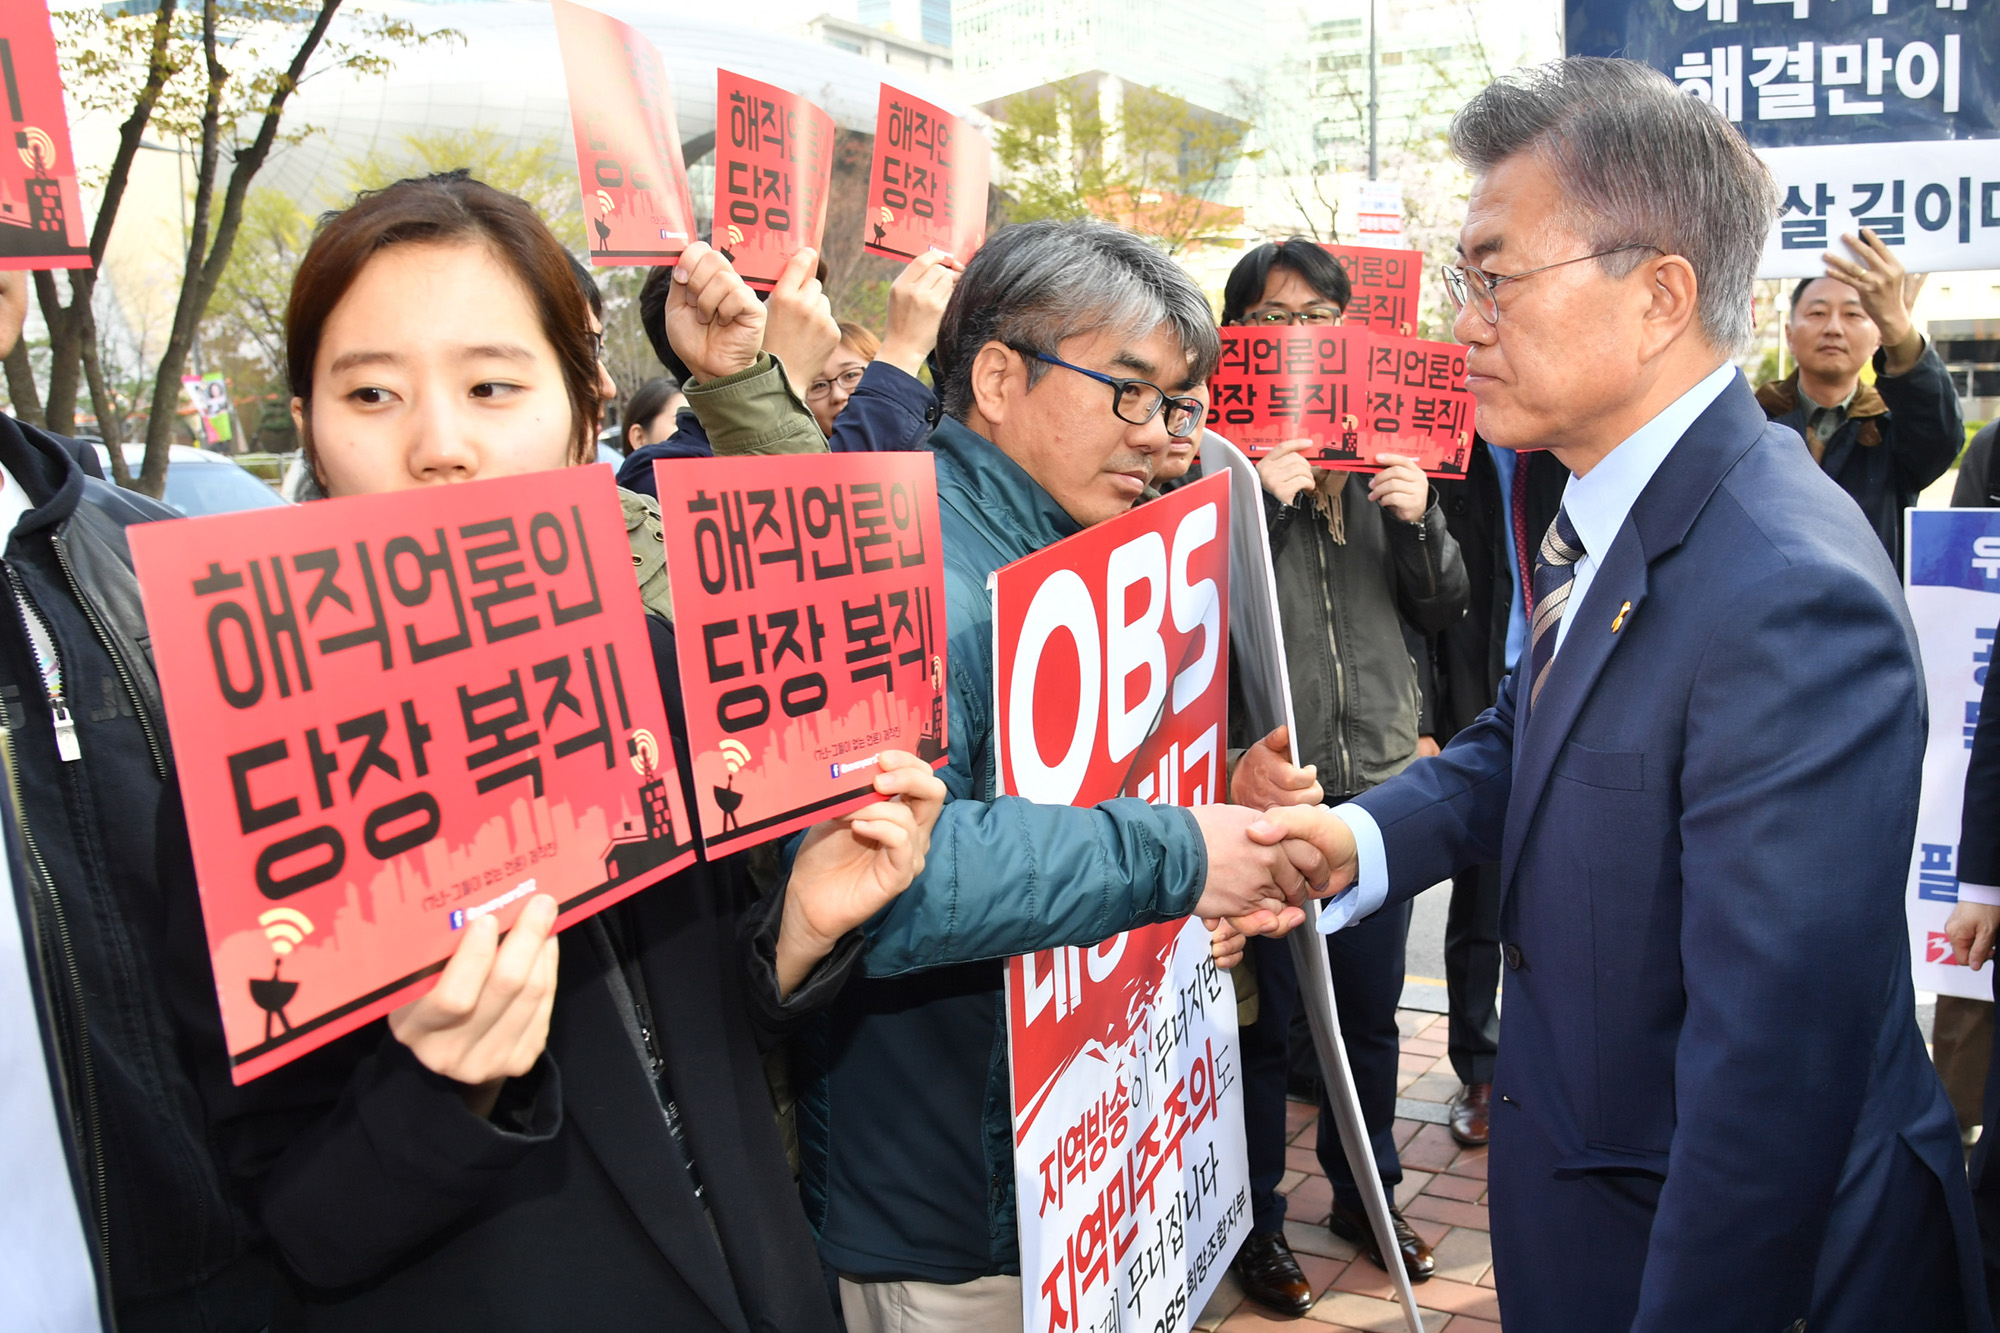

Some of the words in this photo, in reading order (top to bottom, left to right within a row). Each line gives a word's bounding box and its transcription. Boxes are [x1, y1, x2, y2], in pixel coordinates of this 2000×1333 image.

[1674, 34, 1961, 122] 해결만이
[729, 160, 791, 232] 당장
[883, 156, 937, 219] 당장
[1781, 182, 1835, 250] 살
[1337, 255, 1407, 289] 언론인
[1346, 293, 1406, 330] 복직!
[1215, 338, 1347, 376] 직언론인
[1369, 346, 1468, 393] 직언론인
[1268, 383, 1348, 424] 복직!
[1412, 396, 1467, 439] 복직!
[687, 480, 926, 595] 해직언론인
[193, 505, 603, 710] 해직언론인
[702, 605, 828, 733] 당장
[842, 587, 937, 693] 복직!
[1009, 502, 1220, 807] OBS
[227, 700, 442, 900] 당장
[458, 643, 638, 798] 복직!
[1039, 1052, 1150, 1219] 지역방송이
[1155, 940, 1222, 1084] 무너지면
[1042, 1037, 1235, 1333] 지역민주주의도
[1127, 1141, 1219, 1319] 무너집니다
[1187, 1185, 1247, 1299] 희망조합지부
